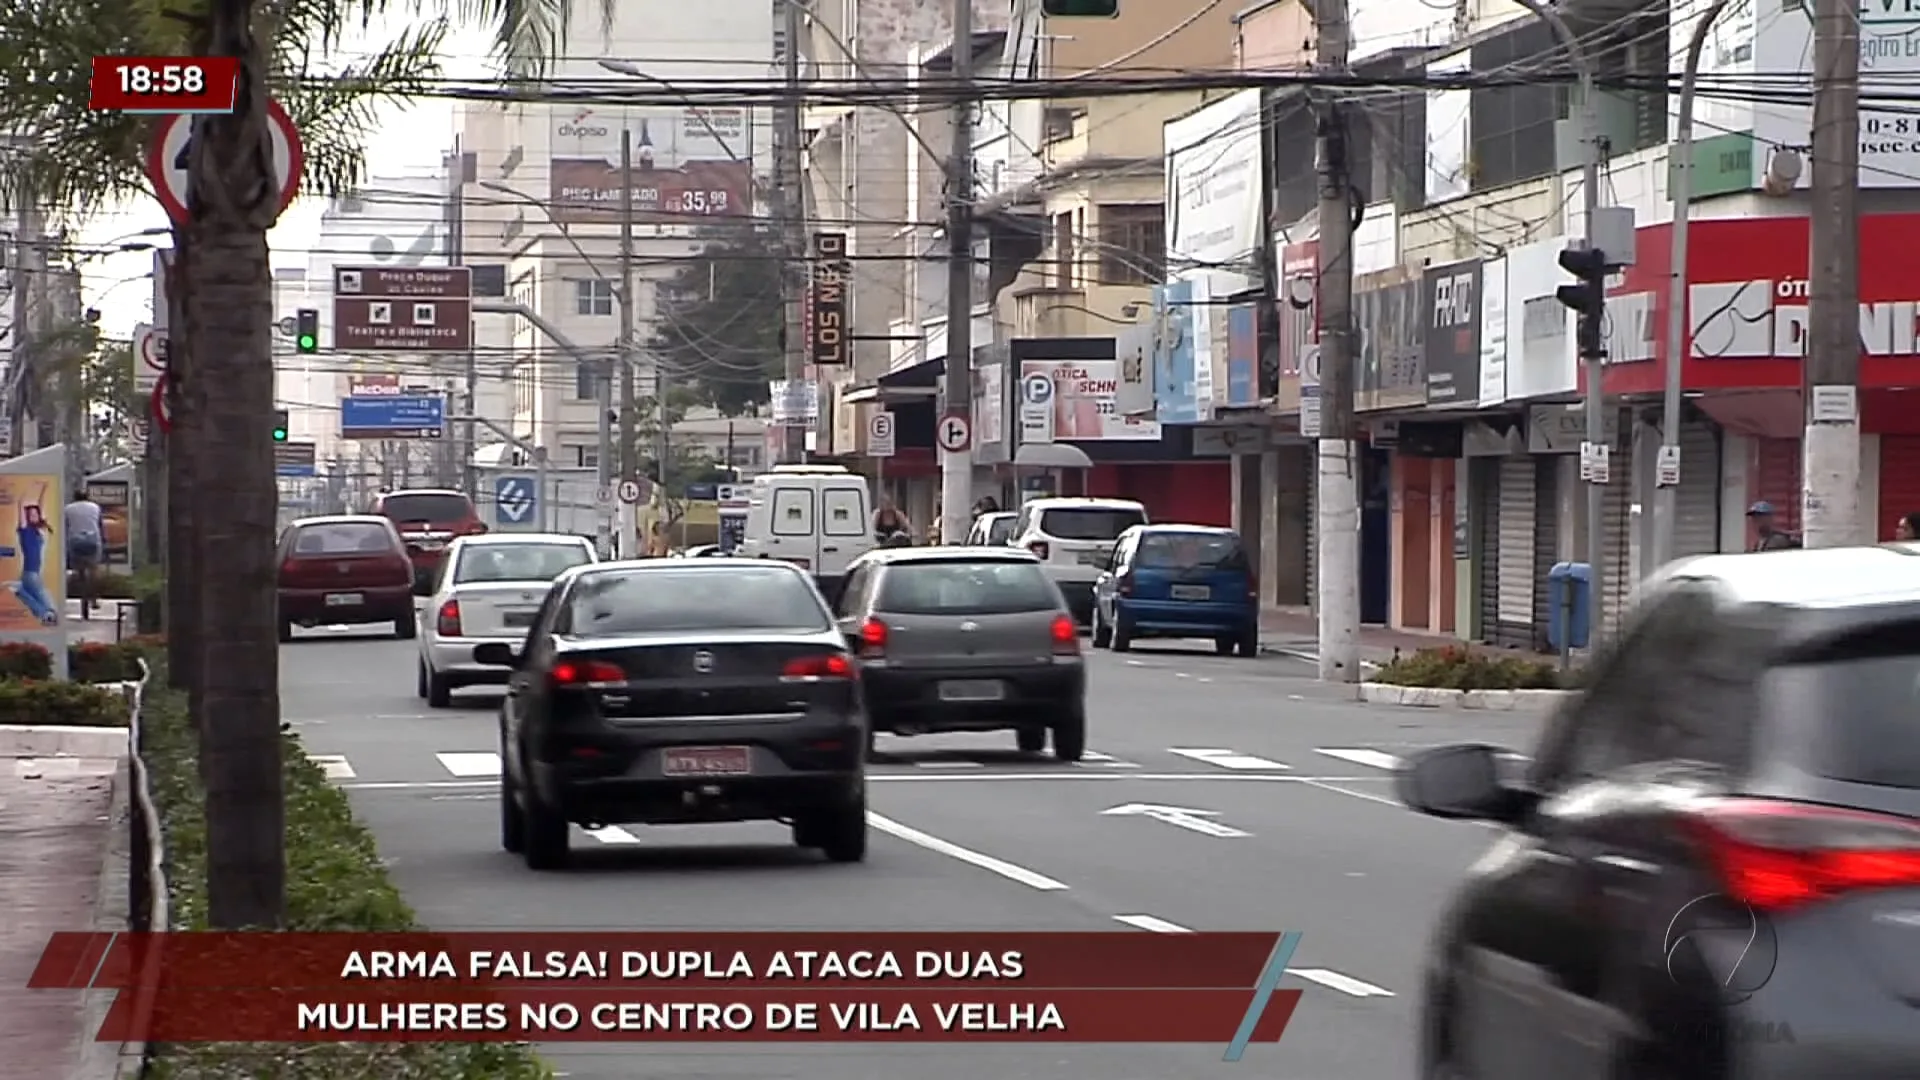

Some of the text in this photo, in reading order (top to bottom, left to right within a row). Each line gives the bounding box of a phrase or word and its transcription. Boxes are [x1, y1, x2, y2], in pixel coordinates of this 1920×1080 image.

[558, 124, 607, 139] divpiso
[682, 191, 728, 214] 35,99
[347, 326, 387, 337] Teatro
[398, 326, 457, 337] Biblioteca
[819, 311, 840, 361] LOS
